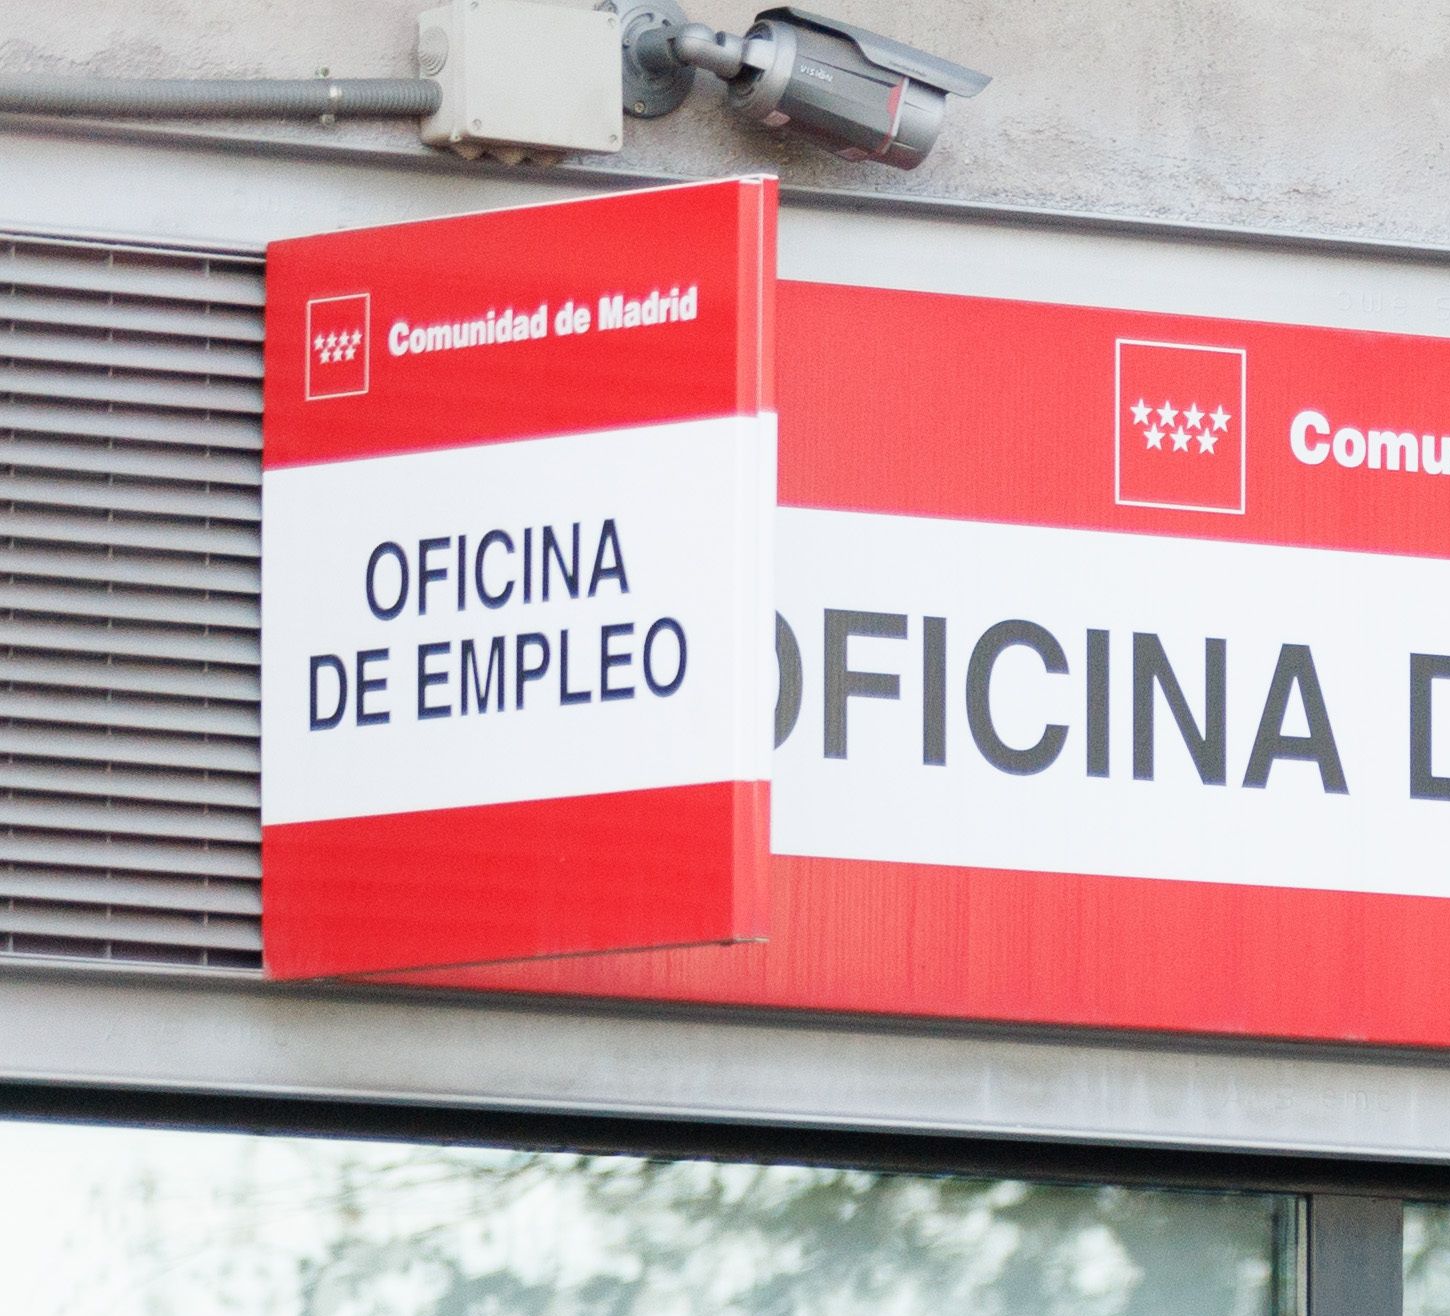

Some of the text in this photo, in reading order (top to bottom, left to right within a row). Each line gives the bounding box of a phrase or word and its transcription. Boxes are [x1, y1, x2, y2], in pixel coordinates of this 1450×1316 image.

[388, 285, 698, 358] Comunidad de Madrid
[365, 517, 629, 622] OFICINA
[309, 614, 689, 732] DE EMPLEO
